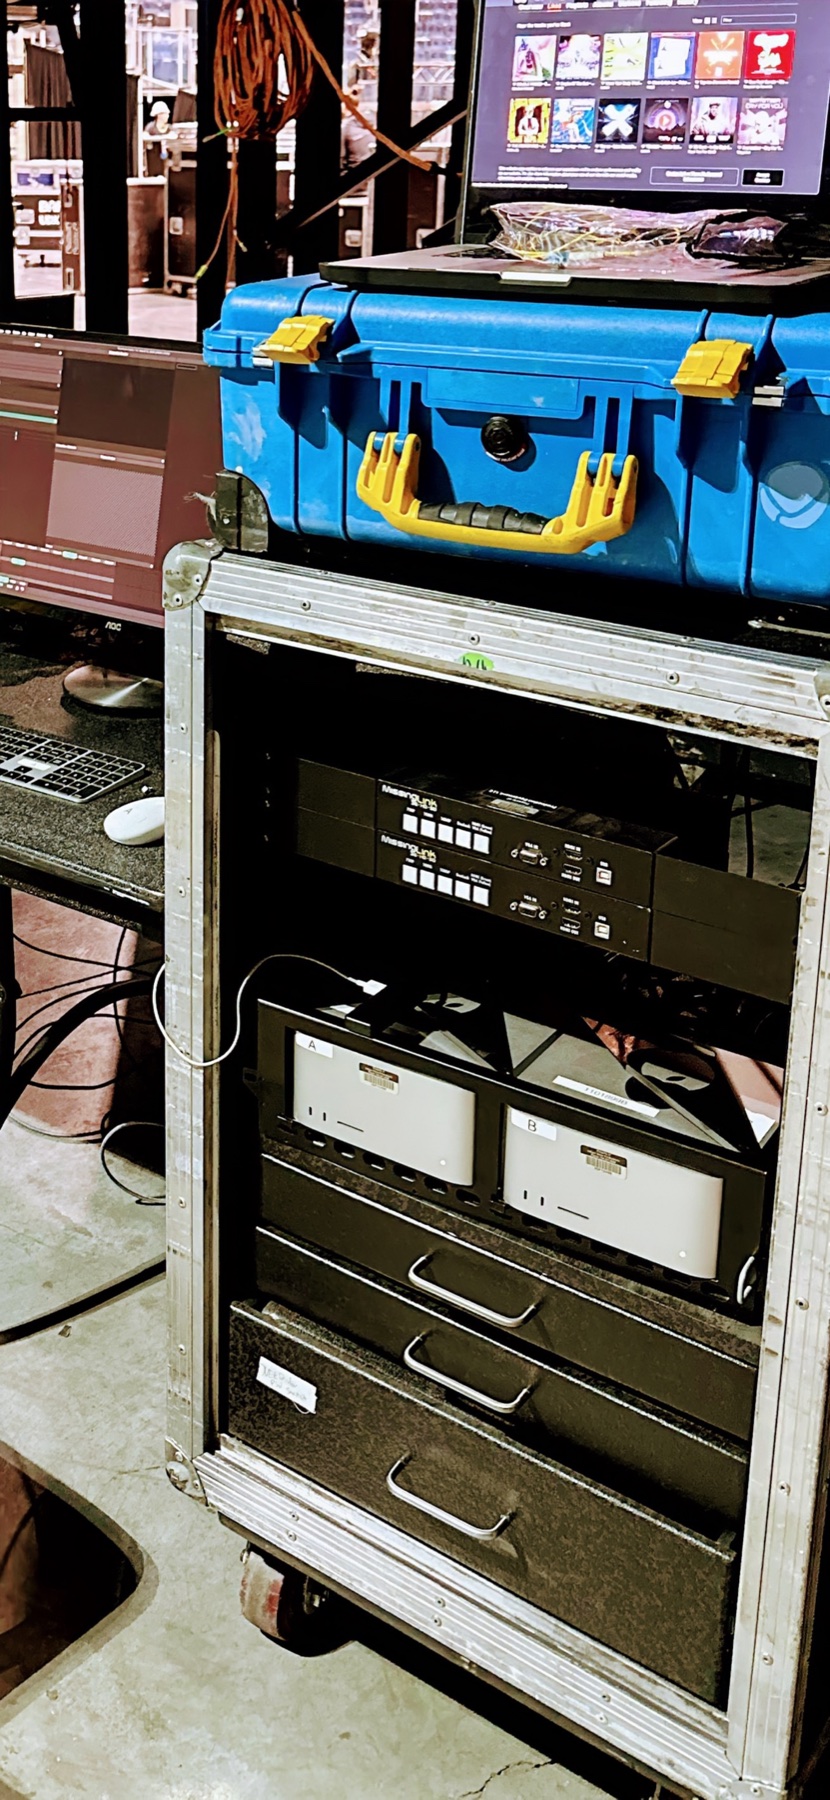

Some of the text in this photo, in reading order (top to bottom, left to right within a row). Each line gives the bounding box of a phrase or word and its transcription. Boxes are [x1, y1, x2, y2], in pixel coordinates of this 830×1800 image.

[105, 621, 121, 631] AOC
[308, 1040, 316, 1051] A
[528, 1119, 537, 1132] B
